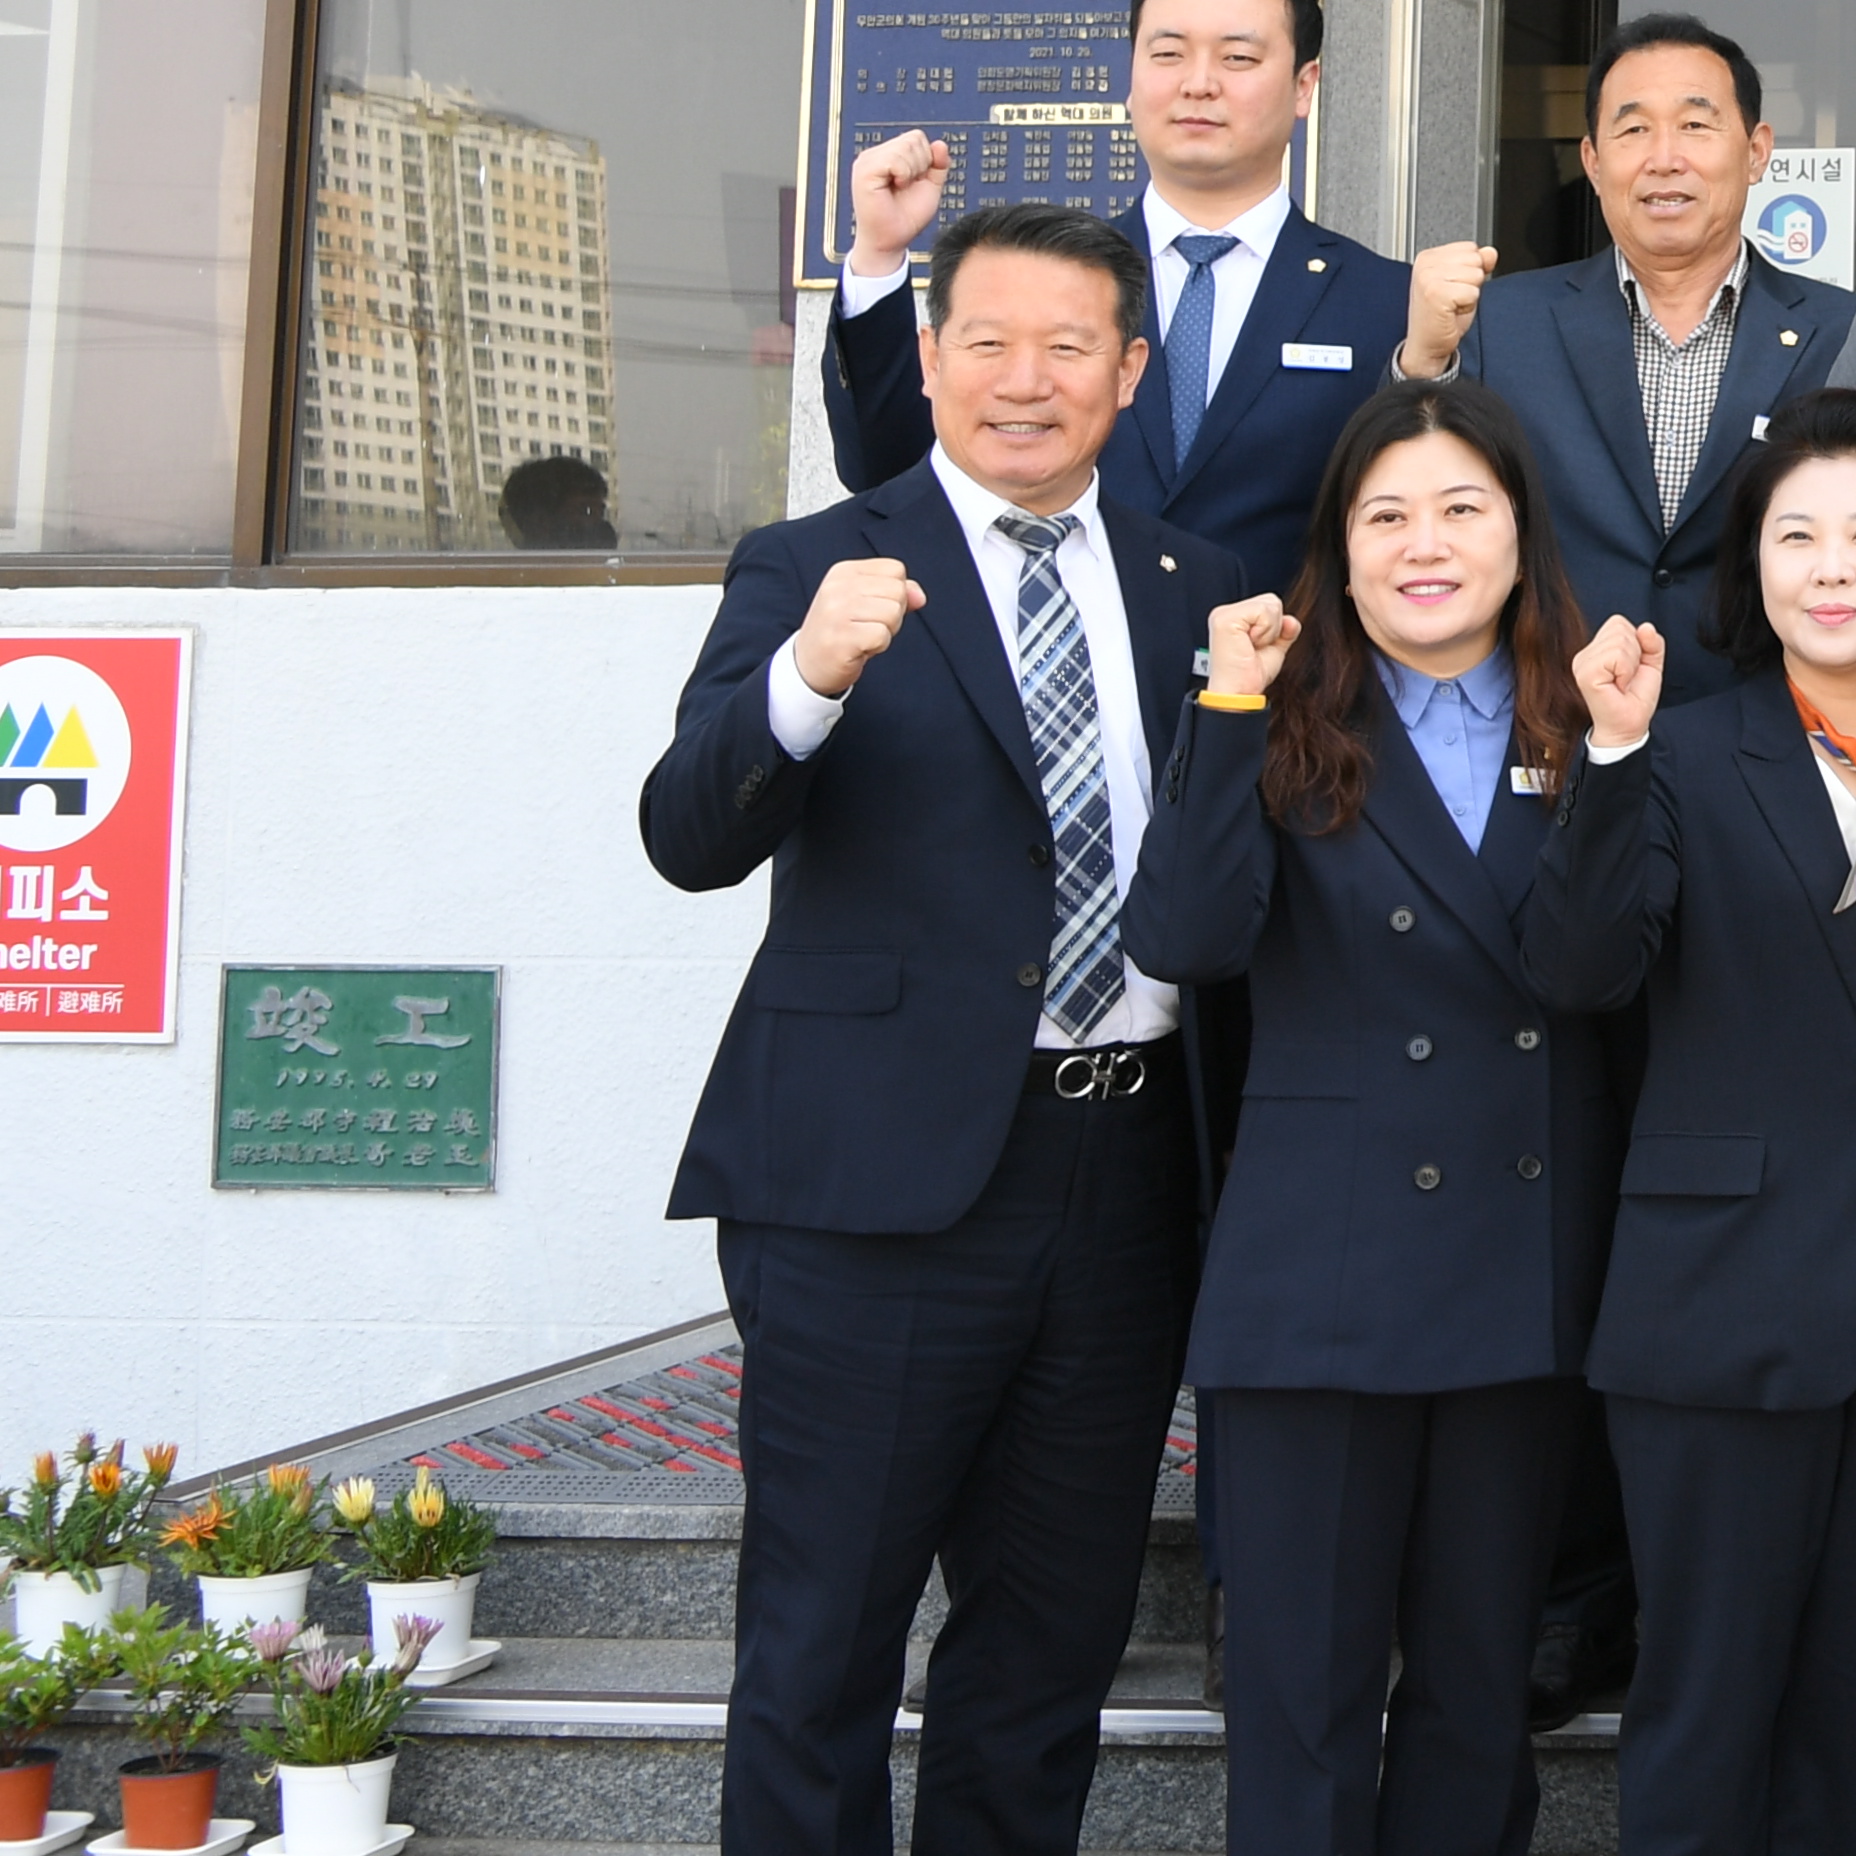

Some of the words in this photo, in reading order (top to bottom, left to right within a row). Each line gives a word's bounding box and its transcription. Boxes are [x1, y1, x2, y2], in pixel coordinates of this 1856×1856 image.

[1032, 106, 1057, 120] 하신
[1060, 105, 1084, 119] 역대
[1088, 104, 1114, 119] 의원
[1759, 158, 1842, 183] 연시설
[0, 864, 109, 922] 피소
[0, 934, 98, 970] elter
[0, 990, 39, 1013] 难所
